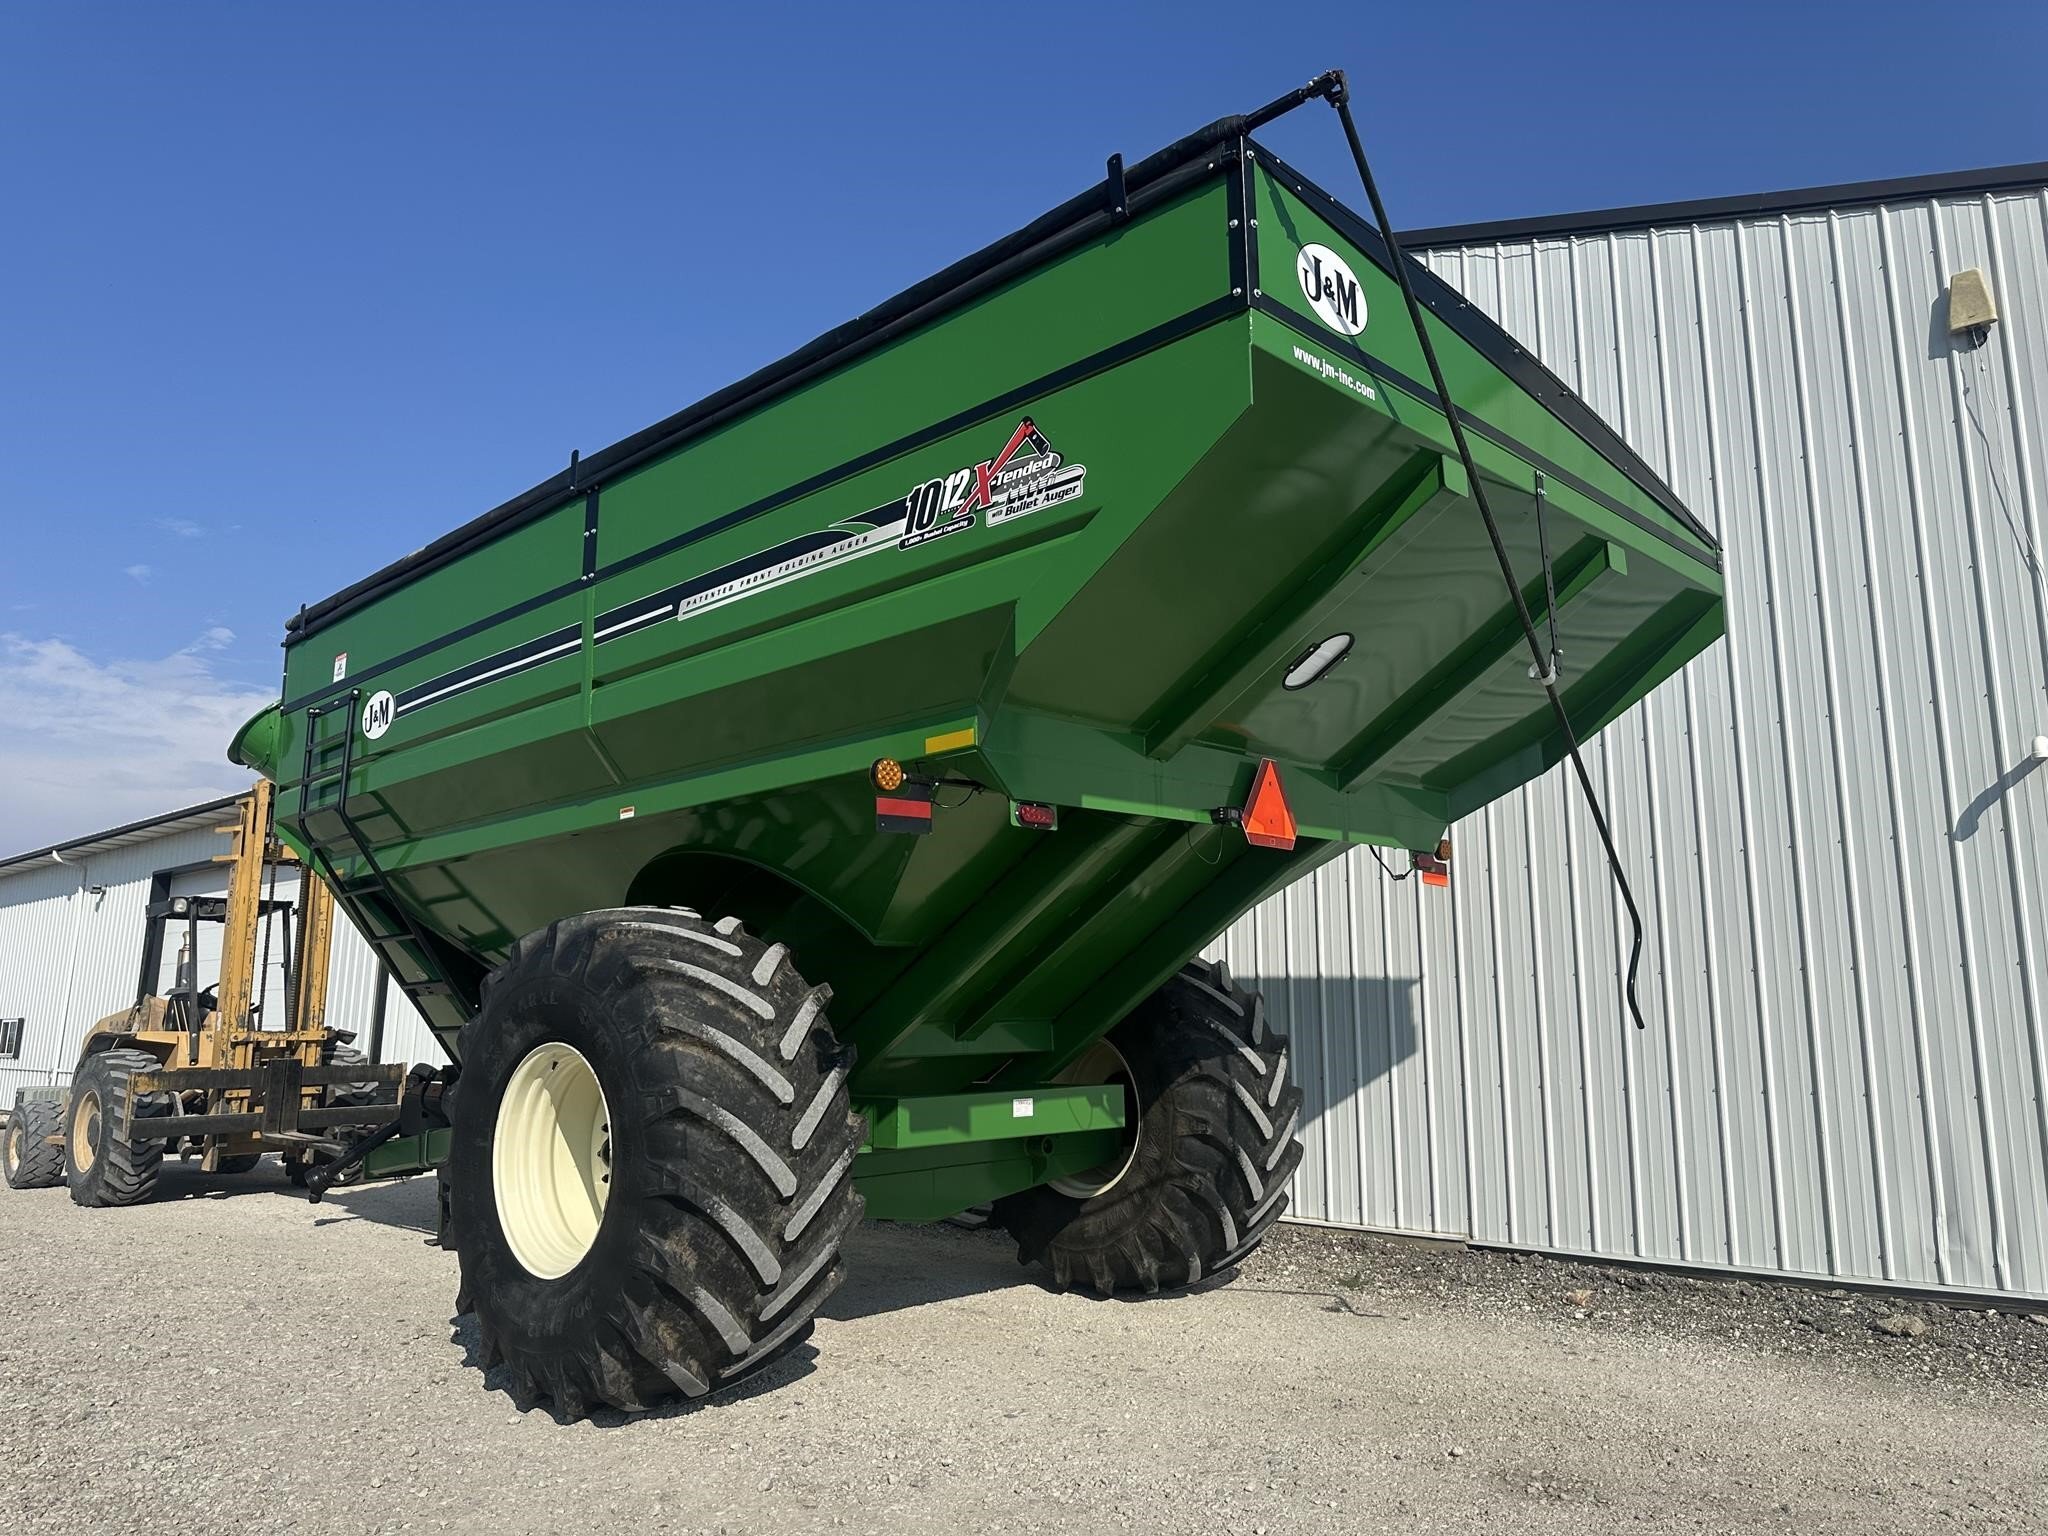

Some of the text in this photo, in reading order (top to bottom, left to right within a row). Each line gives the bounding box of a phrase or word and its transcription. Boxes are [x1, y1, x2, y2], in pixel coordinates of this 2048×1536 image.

[1302, 254, 1359, 328] J&M
[1292, 344, 1376, 401] www.jm-inc.com
[904, 468, 972, 537] 1012
[943, 520, 969, 532] Capacity
[1004, 498, 1039, 517] Bullet
[1041, 484, 1079, 504] Auger
[686, 535, 869, 607] PATENTED FRONT FOLDING AUGER
[364, 696, 391, 733] J&M
